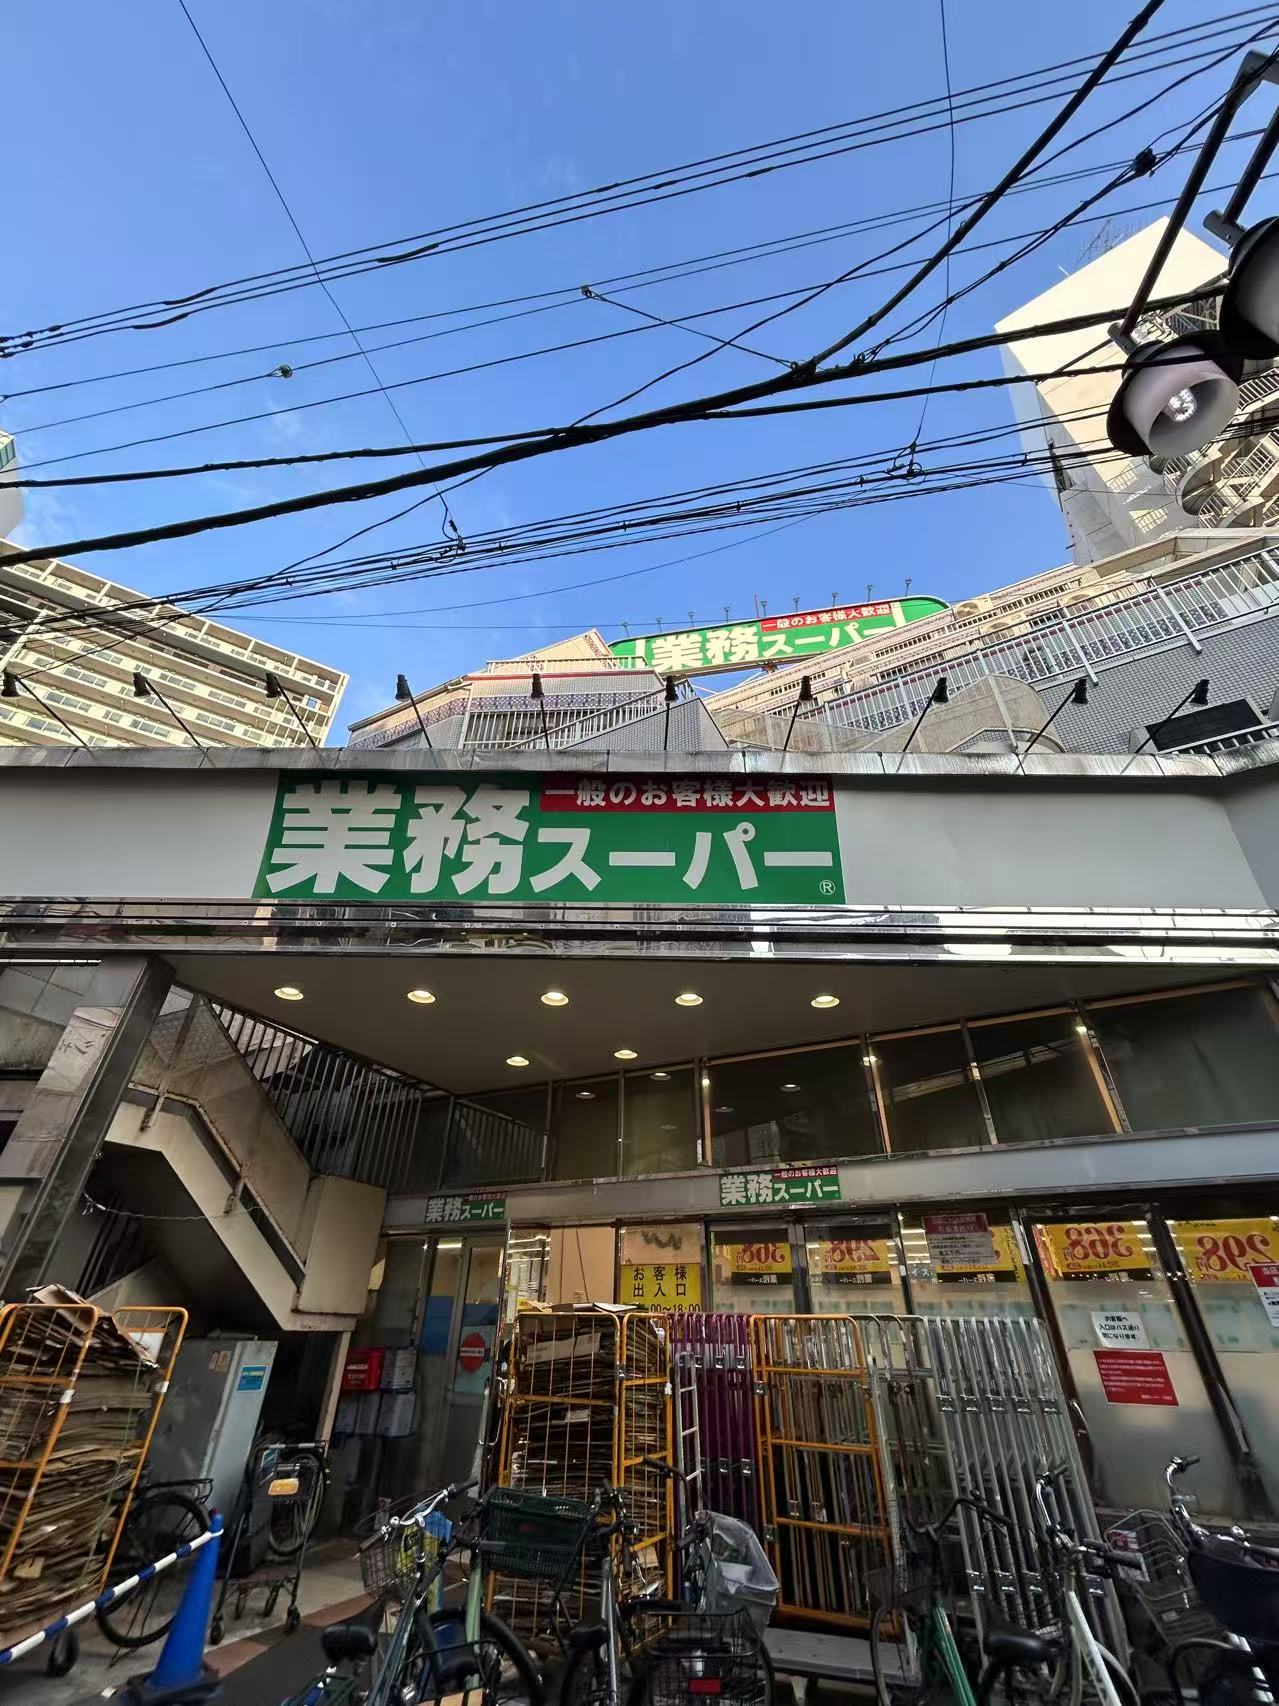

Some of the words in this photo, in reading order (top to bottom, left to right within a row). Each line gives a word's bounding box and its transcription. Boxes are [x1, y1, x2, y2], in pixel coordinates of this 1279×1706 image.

[763, 604, 891, 629] 一般のお客様大歓迎
[651, 621, 897, 669] 業務スーパー
[545, 778, 830, 808] 一般のお客様大歓迎
[265, 778, 833, 894] 業務スーパー
[721, 1173, 838, 1204] 業務スーパー
[426, 1197, 503, 1222] 業務スーパー
[633, 1265, 688, 1281] お客様
[633, 1282, 687, 1297] 出入口
